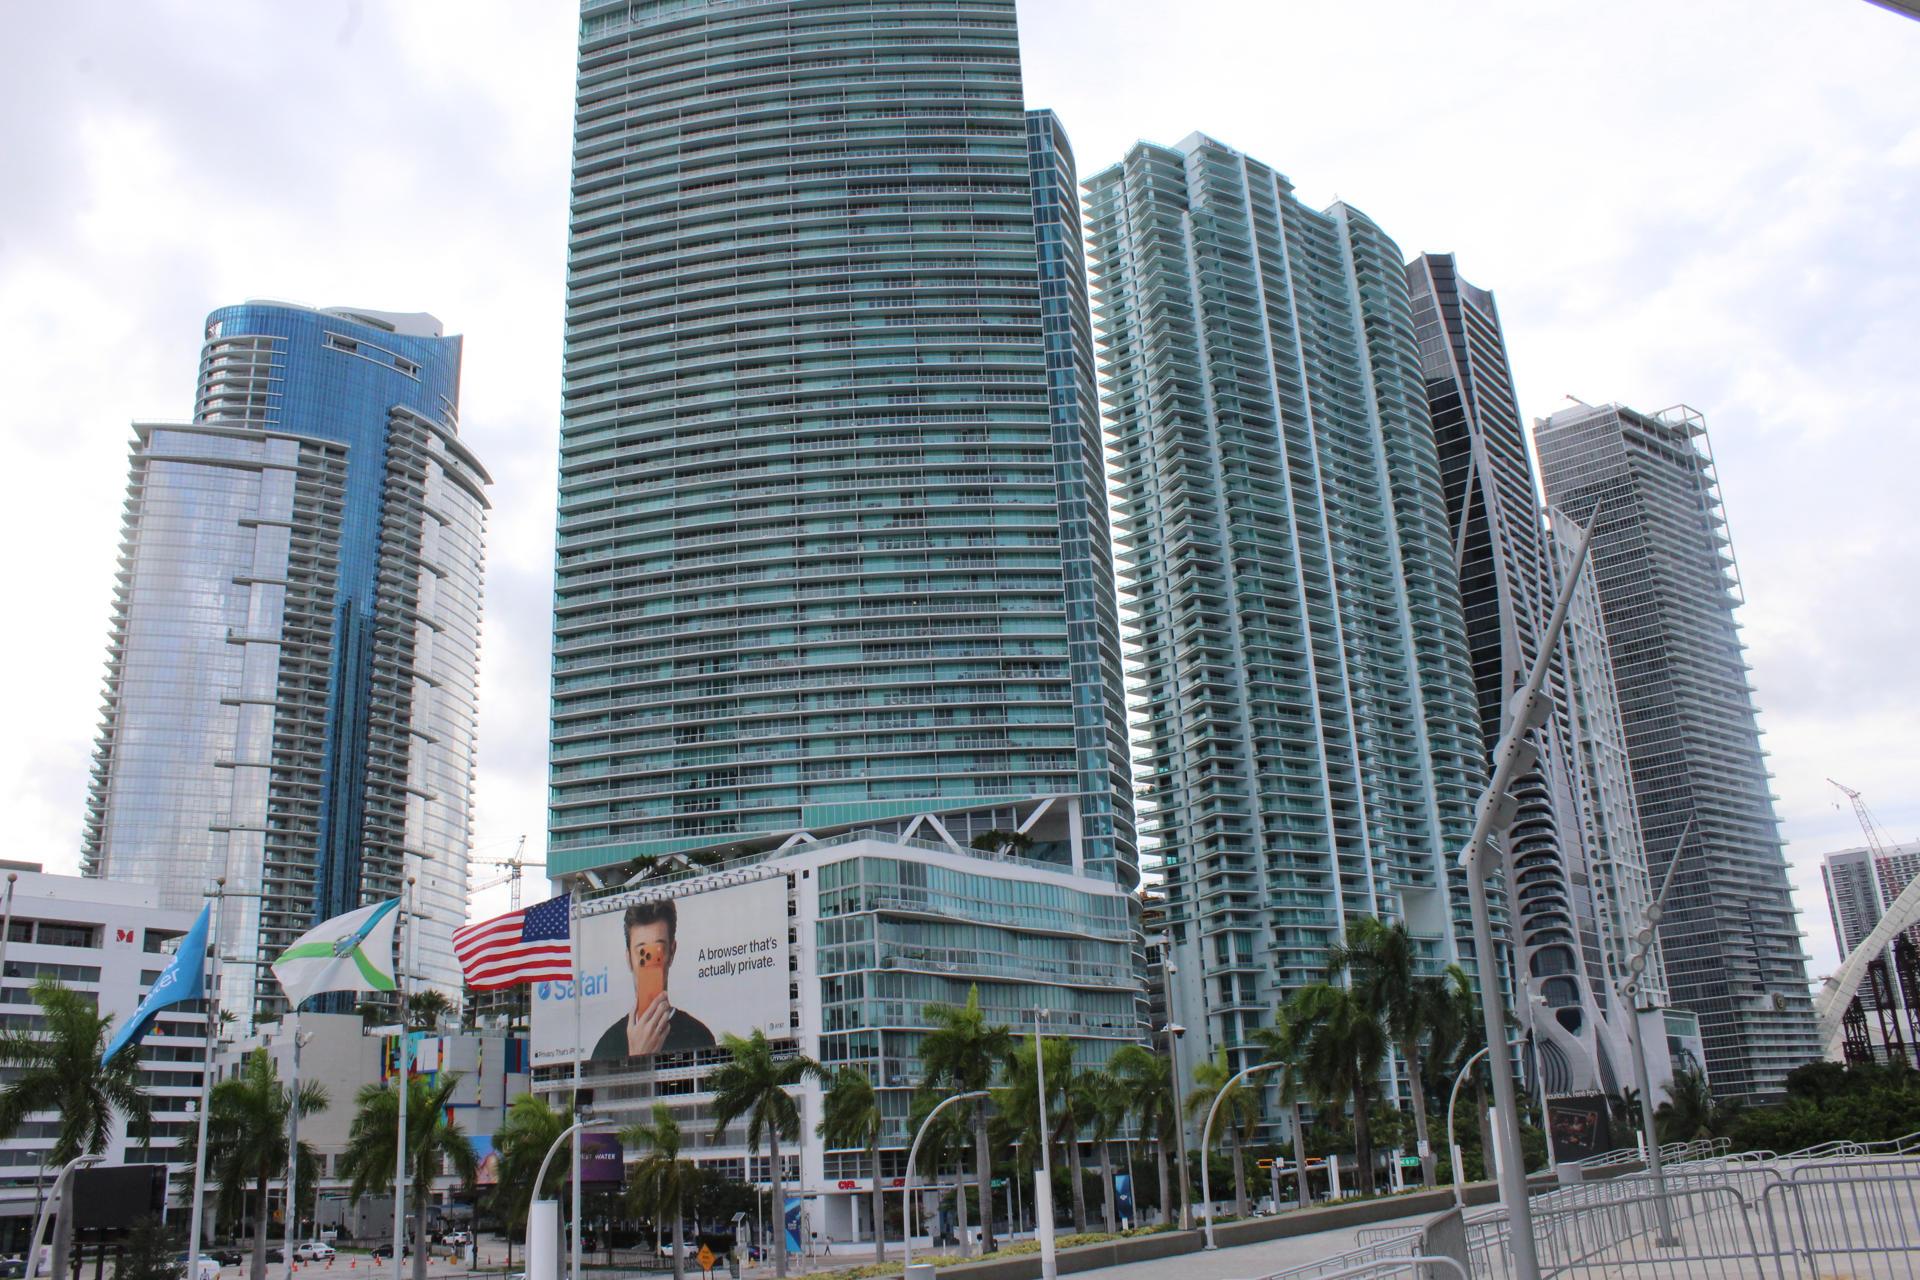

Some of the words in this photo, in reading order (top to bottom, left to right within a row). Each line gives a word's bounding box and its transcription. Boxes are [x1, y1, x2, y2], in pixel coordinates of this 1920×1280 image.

[698, 948, 706, 962] A
[707, 944, 748, 961] browser
[749, 937, 777, 953] that's
[698, 960, 736, 978] actually
[738, 955, 776, 975] private.
[554, 966, 608, 1001] Safari
